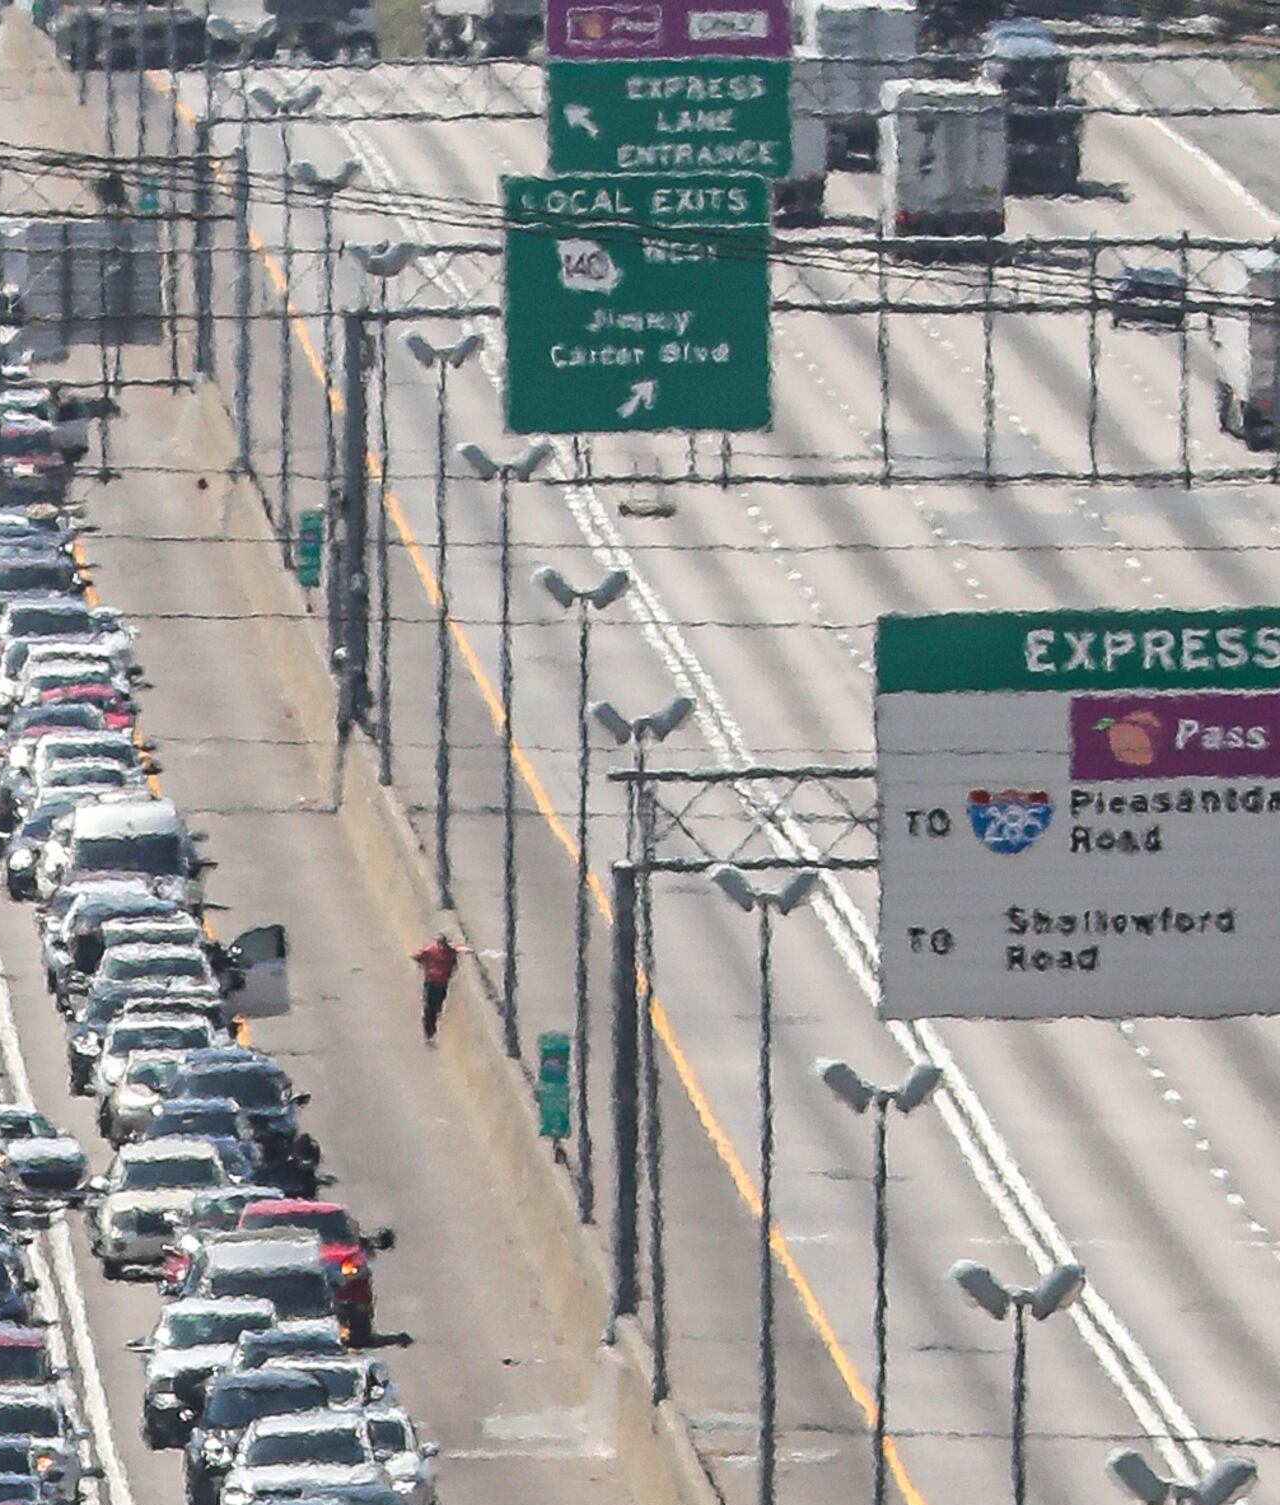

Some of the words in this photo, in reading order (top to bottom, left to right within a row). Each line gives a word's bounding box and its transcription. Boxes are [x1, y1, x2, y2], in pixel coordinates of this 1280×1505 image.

[626, 74, 766, 101] EXPRESS
[656, 107, 736, 133] LANE
[616, 140, 778, 168] ENTRANCE
[521, 189, 633, 216] LOCAL
[651, 187, 748, 214] EXITS
[586, 309, 692, 337] Jimmy
[550, 343, 644, 369] Carter
[659, 342, 730, 364] Blvd
[1025, 627, 1280, 673] EXPRESS
[1175, 718, 1269, 750] Pass
[904, 807, 952, 838] TO
[1070, 824, 1163, 854] Road
[1005, 904, 1236, 935] Shallowford
[906, 926, 954, 956] TO
[1006, 944, 1101, 972] Road
